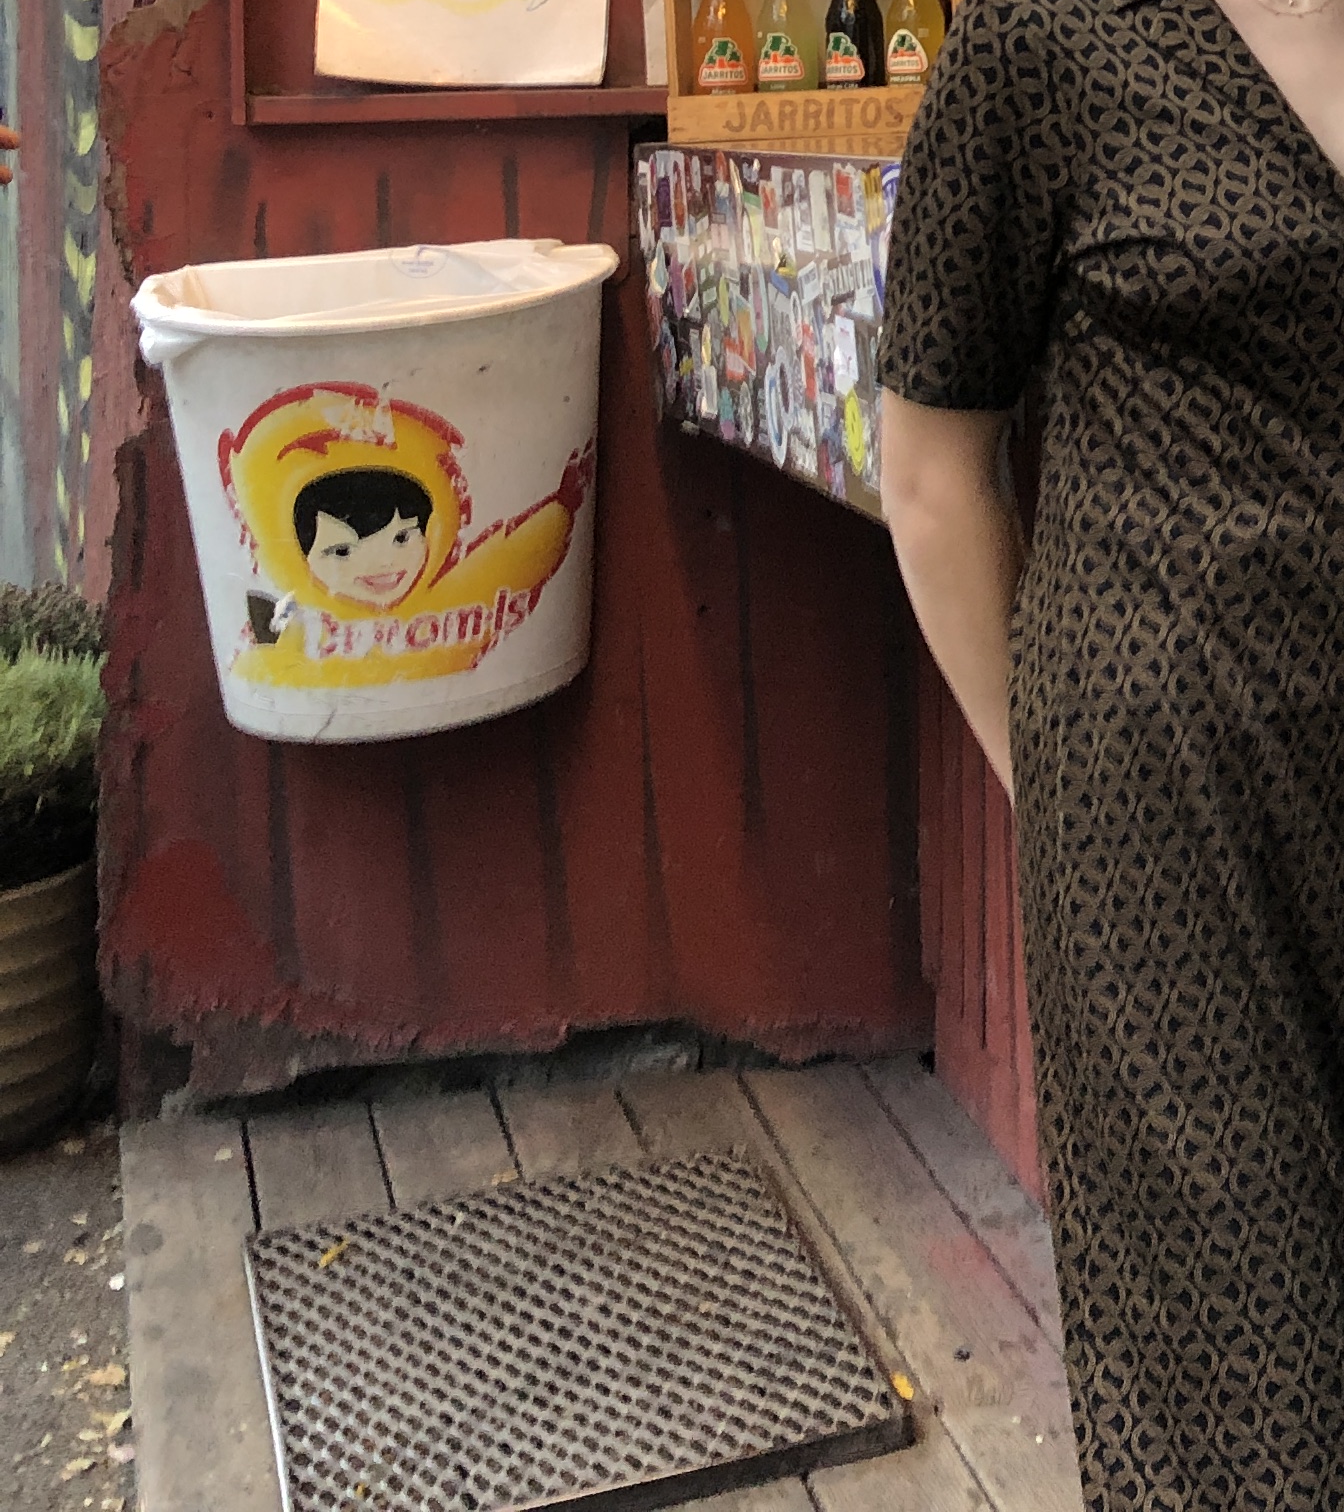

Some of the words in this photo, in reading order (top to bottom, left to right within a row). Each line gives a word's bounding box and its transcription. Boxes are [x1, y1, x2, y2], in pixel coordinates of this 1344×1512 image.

[703, 69, 744, 81] JARRITOS
[761, 64, 799, 75] JARRITOS
[723, 97, 904, 133] JARRITOS
